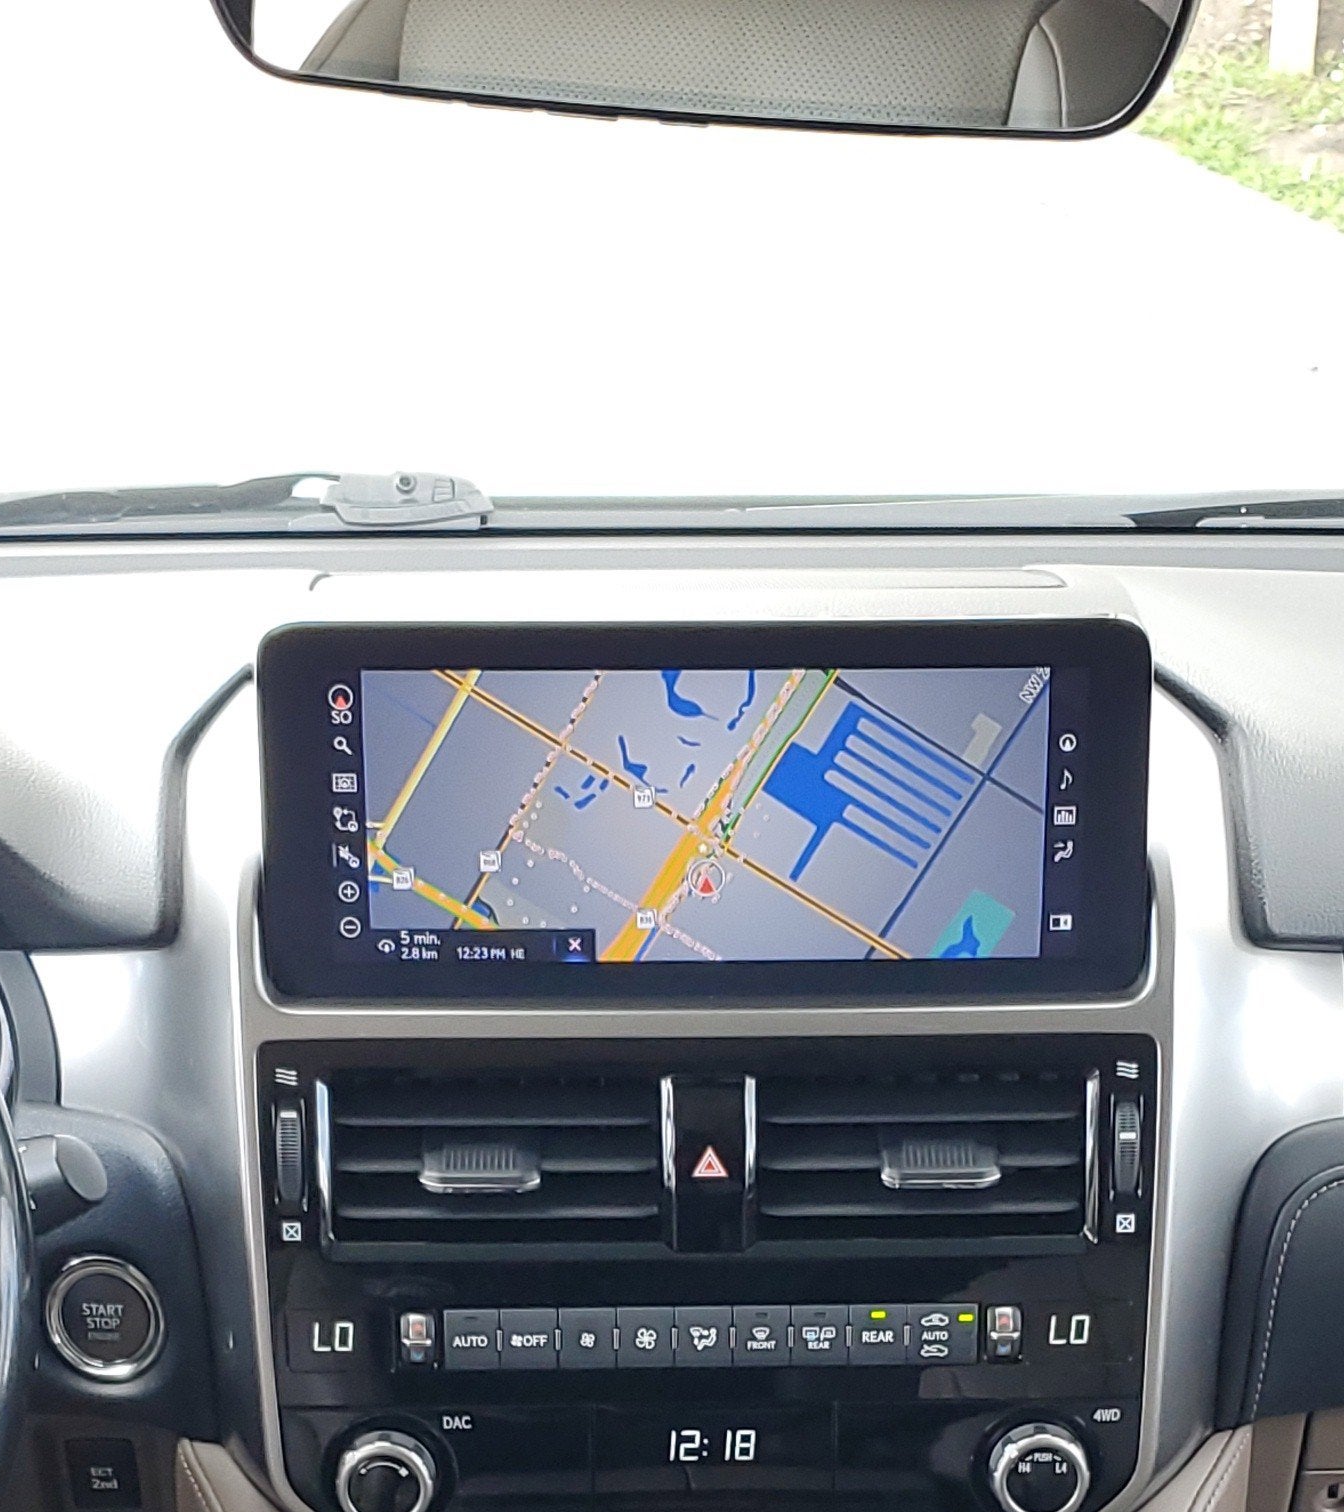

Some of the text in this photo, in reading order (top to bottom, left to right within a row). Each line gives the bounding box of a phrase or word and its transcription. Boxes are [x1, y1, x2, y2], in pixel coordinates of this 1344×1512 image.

[331, 710, 353, 725] SO
[400, 931, 441, 946] 5 min.
[400, 947, 439, 960] 2.8 km
[457, 947, 489, 960] 12:23
[490, 949, 506, 960] PM
[81, 1302, 124, 1317] START
[86, 1317, 121, 1330] STOP
[1048, 1314, 1091, 1346] LO
[312, 1320, 355, 1353] LO
[452, 1334, 488, 1348] AUTO
[523, 1333, 548, 1347] OFF
[861, 1329, 895, 1344] REAR
[921, 1331, 949, 1342] AUTO
[746, 1340, 776, 1351] FRONT
[807, 1340, 831, 1351] REAR
[1092, 1408, 1121, 1422] 4WD
[442, 1416, 473, 1430] DAC
[669, 1429, 756, 1462] 12:18
[1055, 1462, 1067, 1475] L4
[90, 1478, 118, 1489] 2nd
